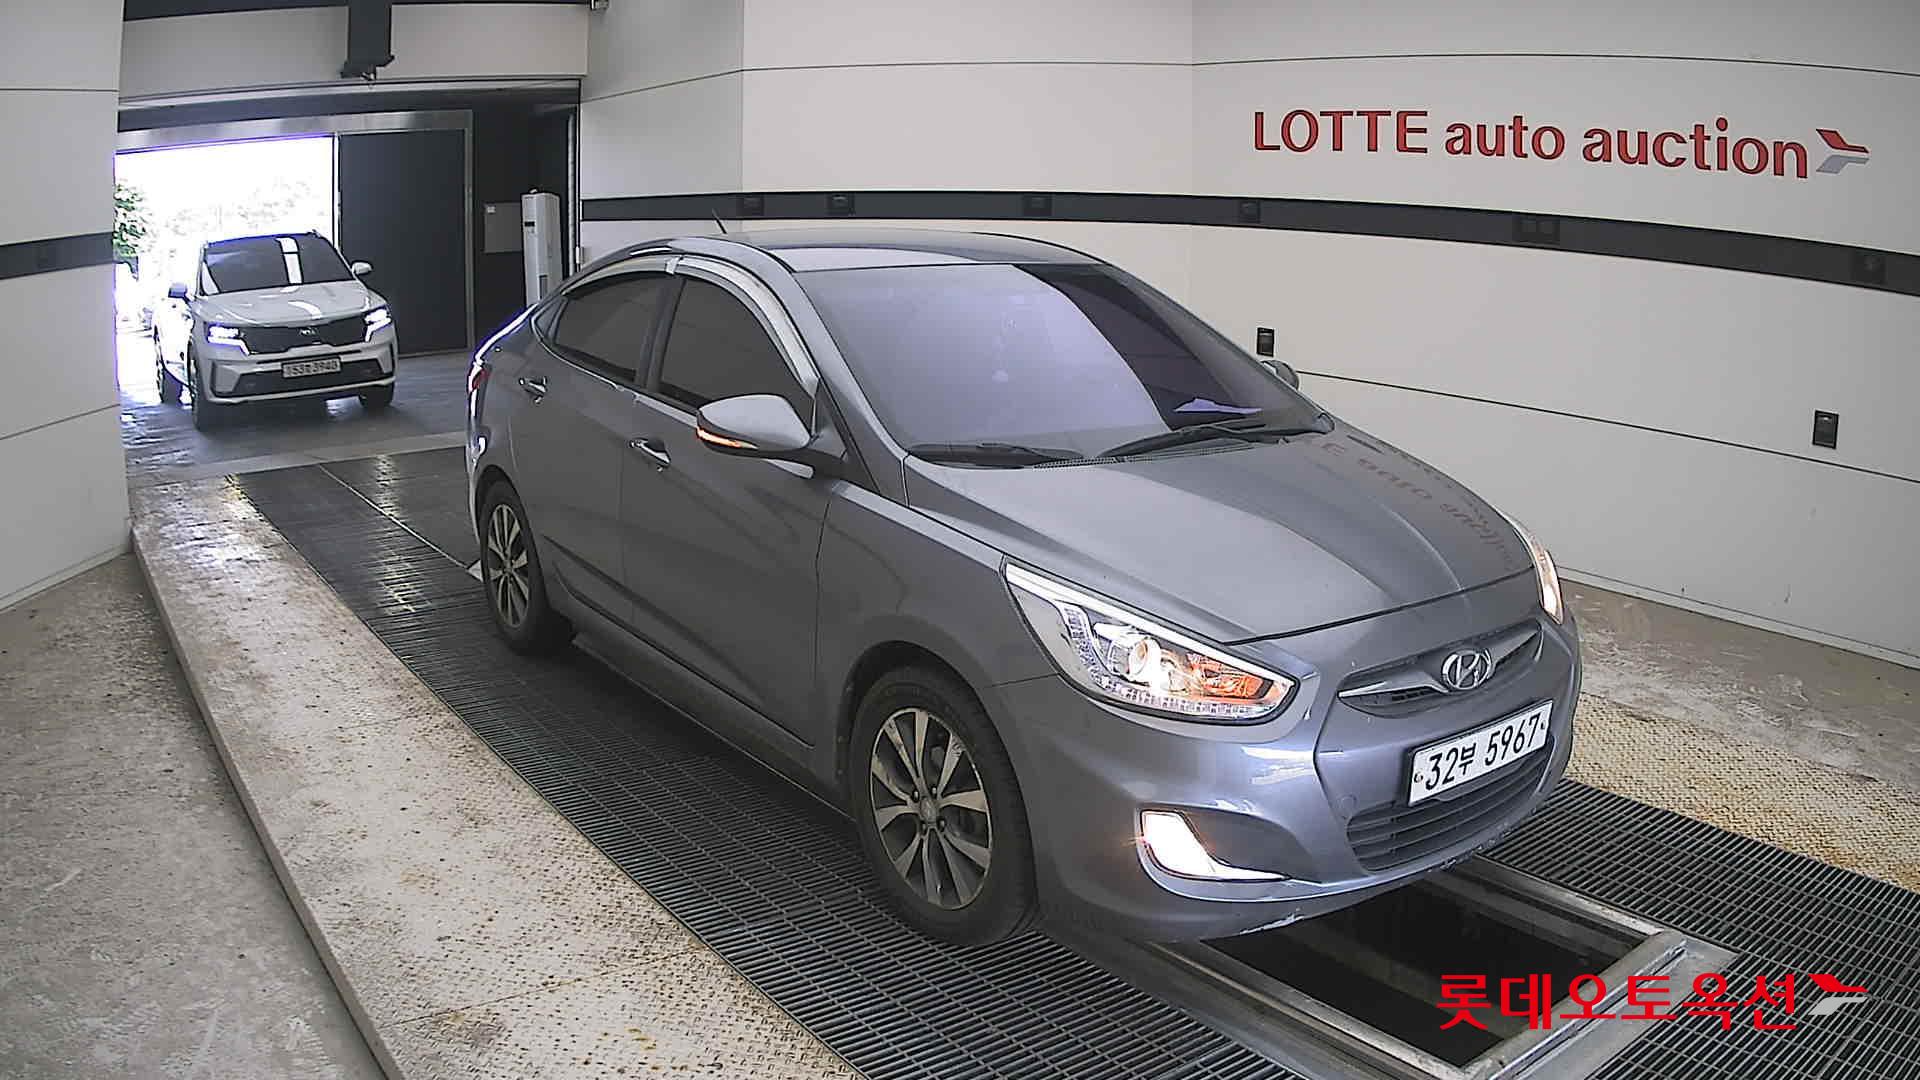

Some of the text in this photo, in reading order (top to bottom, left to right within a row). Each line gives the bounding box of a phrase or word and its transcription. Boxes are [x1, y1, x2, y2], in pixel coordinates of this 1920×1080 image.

[1254, 110, 1808, 179] LOTTE auto auction
[1425, 702, 1541, 790] 32부 5967
